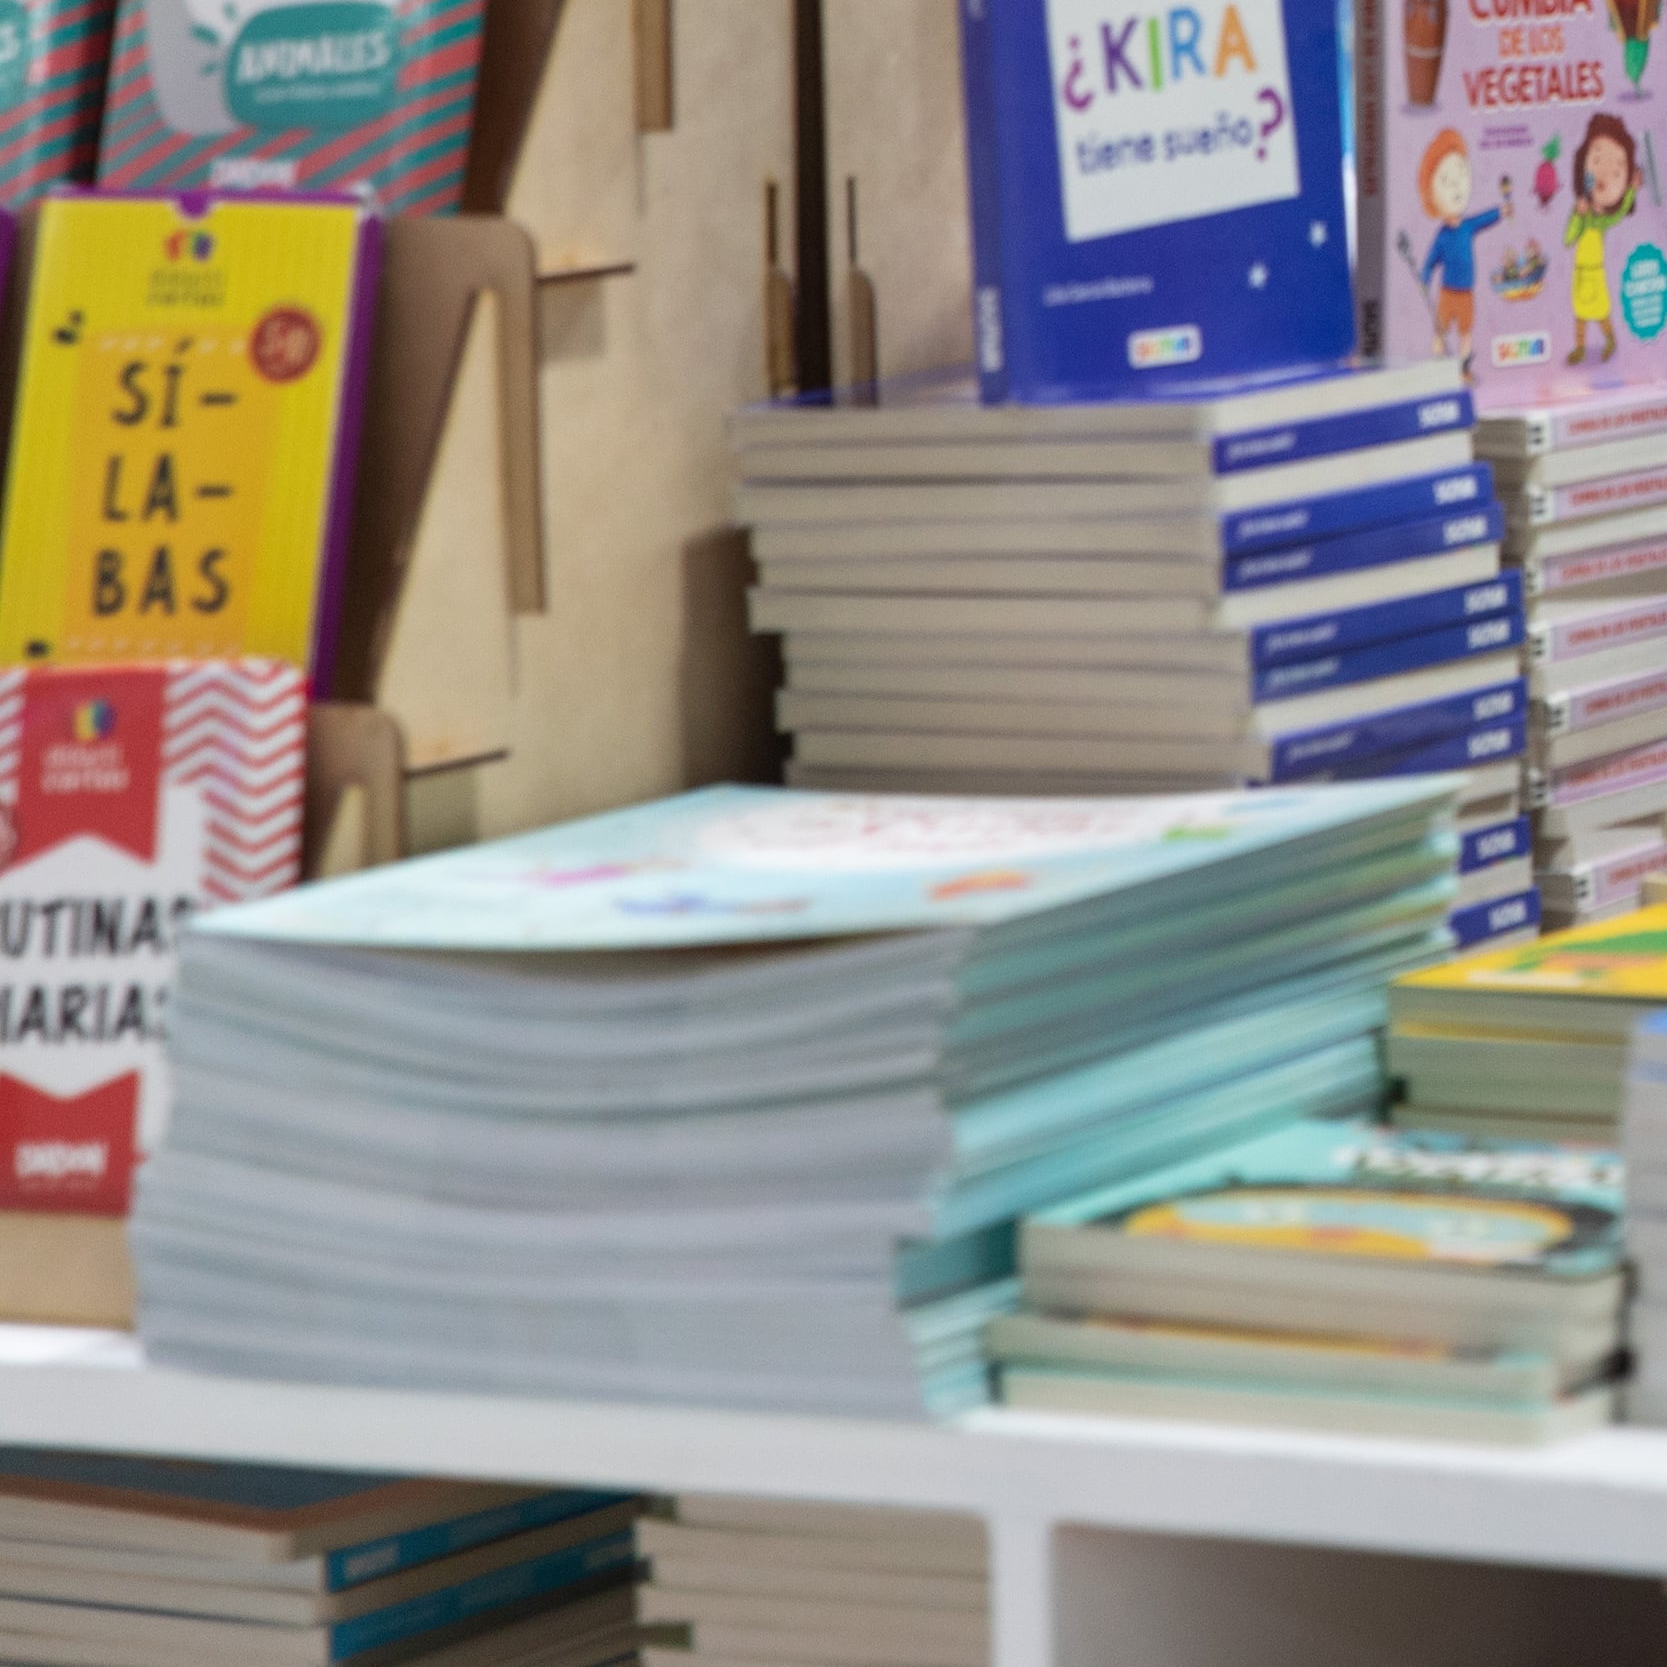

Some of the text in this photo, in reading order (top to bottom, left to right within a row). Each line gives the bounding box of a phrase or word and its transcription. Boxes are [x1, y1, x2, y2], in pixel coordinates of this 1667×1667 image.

[236, 32, 390, 85] ANIMALES
[1063, 3, 1257, 113] ¿KIRA
[1499, 26, 1564, 57] DE LOS
[1463, 61, 1605, 109] VEGETALES
[1076, 137, 1157, 175] tiene
[92, 545, 230, 617] BAS
[0, 895, 195, 958] UTINA
